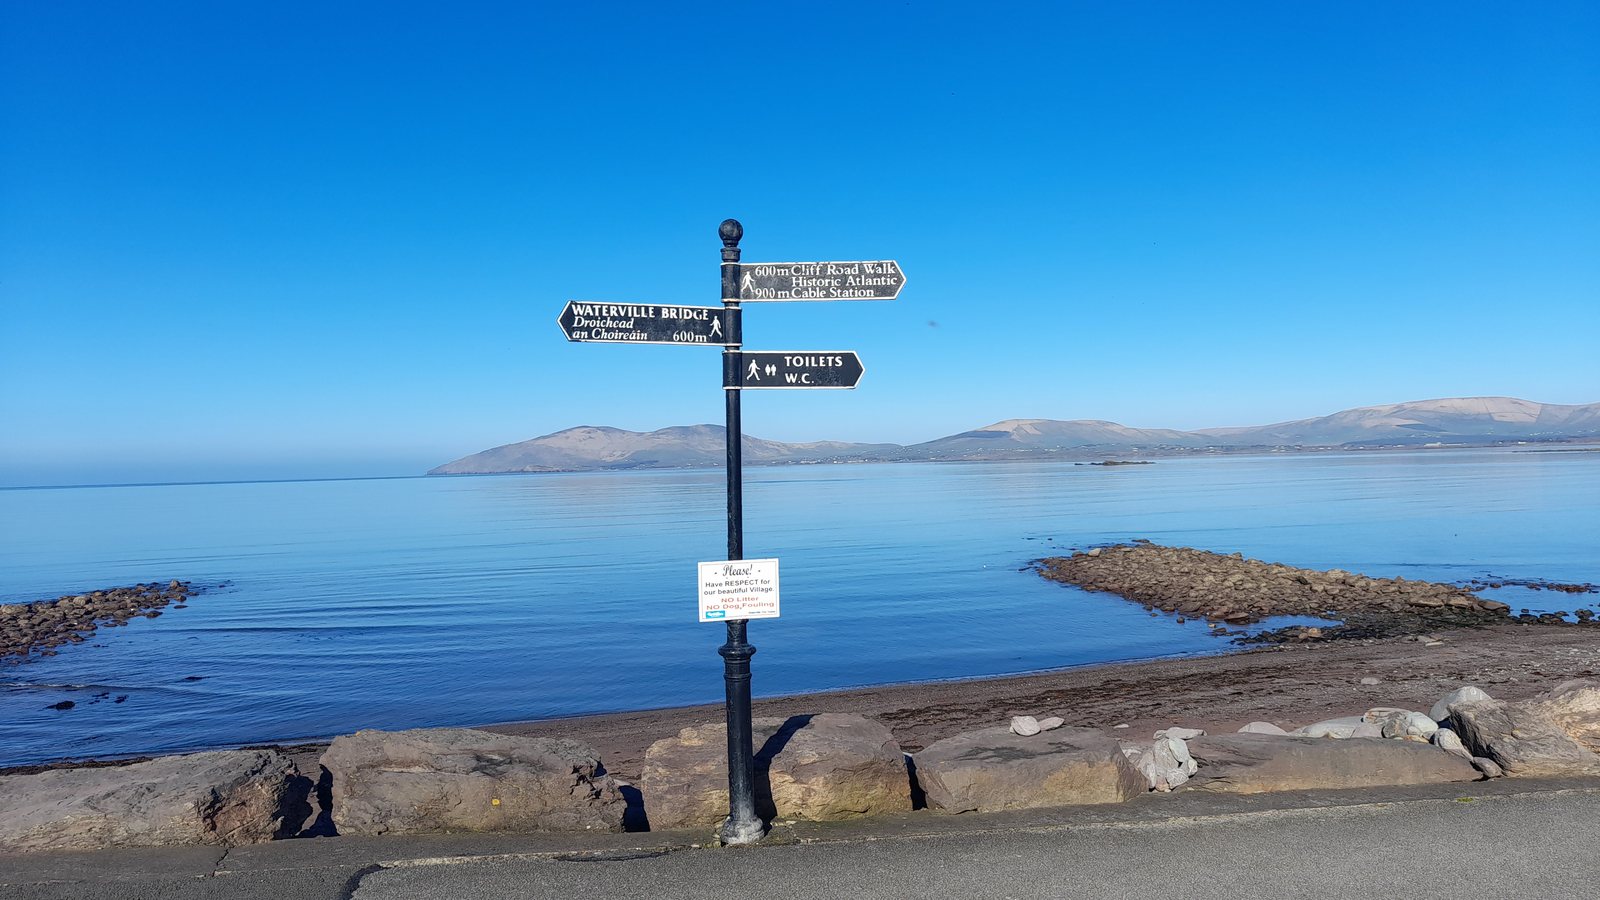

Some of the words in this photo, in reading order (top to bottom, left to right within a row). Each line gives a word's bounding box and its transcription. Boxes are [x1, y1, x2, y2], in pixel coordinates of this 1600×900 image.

[755, 265, 789, 276] 600m
[791, 264, 822, 276] Cliff
[827, 264, 858, 275] Road
[863, 263, 896, 274] Walk
[792, 276, 841, 288] Historic
[846, 275, 898, 286] Atlantic
[792, 287, 826, 298] Cable
[830, 287, 874, 298] Station
[571, 304, 655, 318] WATERVILLE
[662, 308, 708, 320] BRIDGE
[572, 316, 634, 329] Droichead
[572, 330, 588, 340] an
[672, 330, 708, 342] 600m
[784, 356, 843, 366] TOILETS
[784, 373, 814, 384] W.C.
[722, 564, 752, 576] Please!
